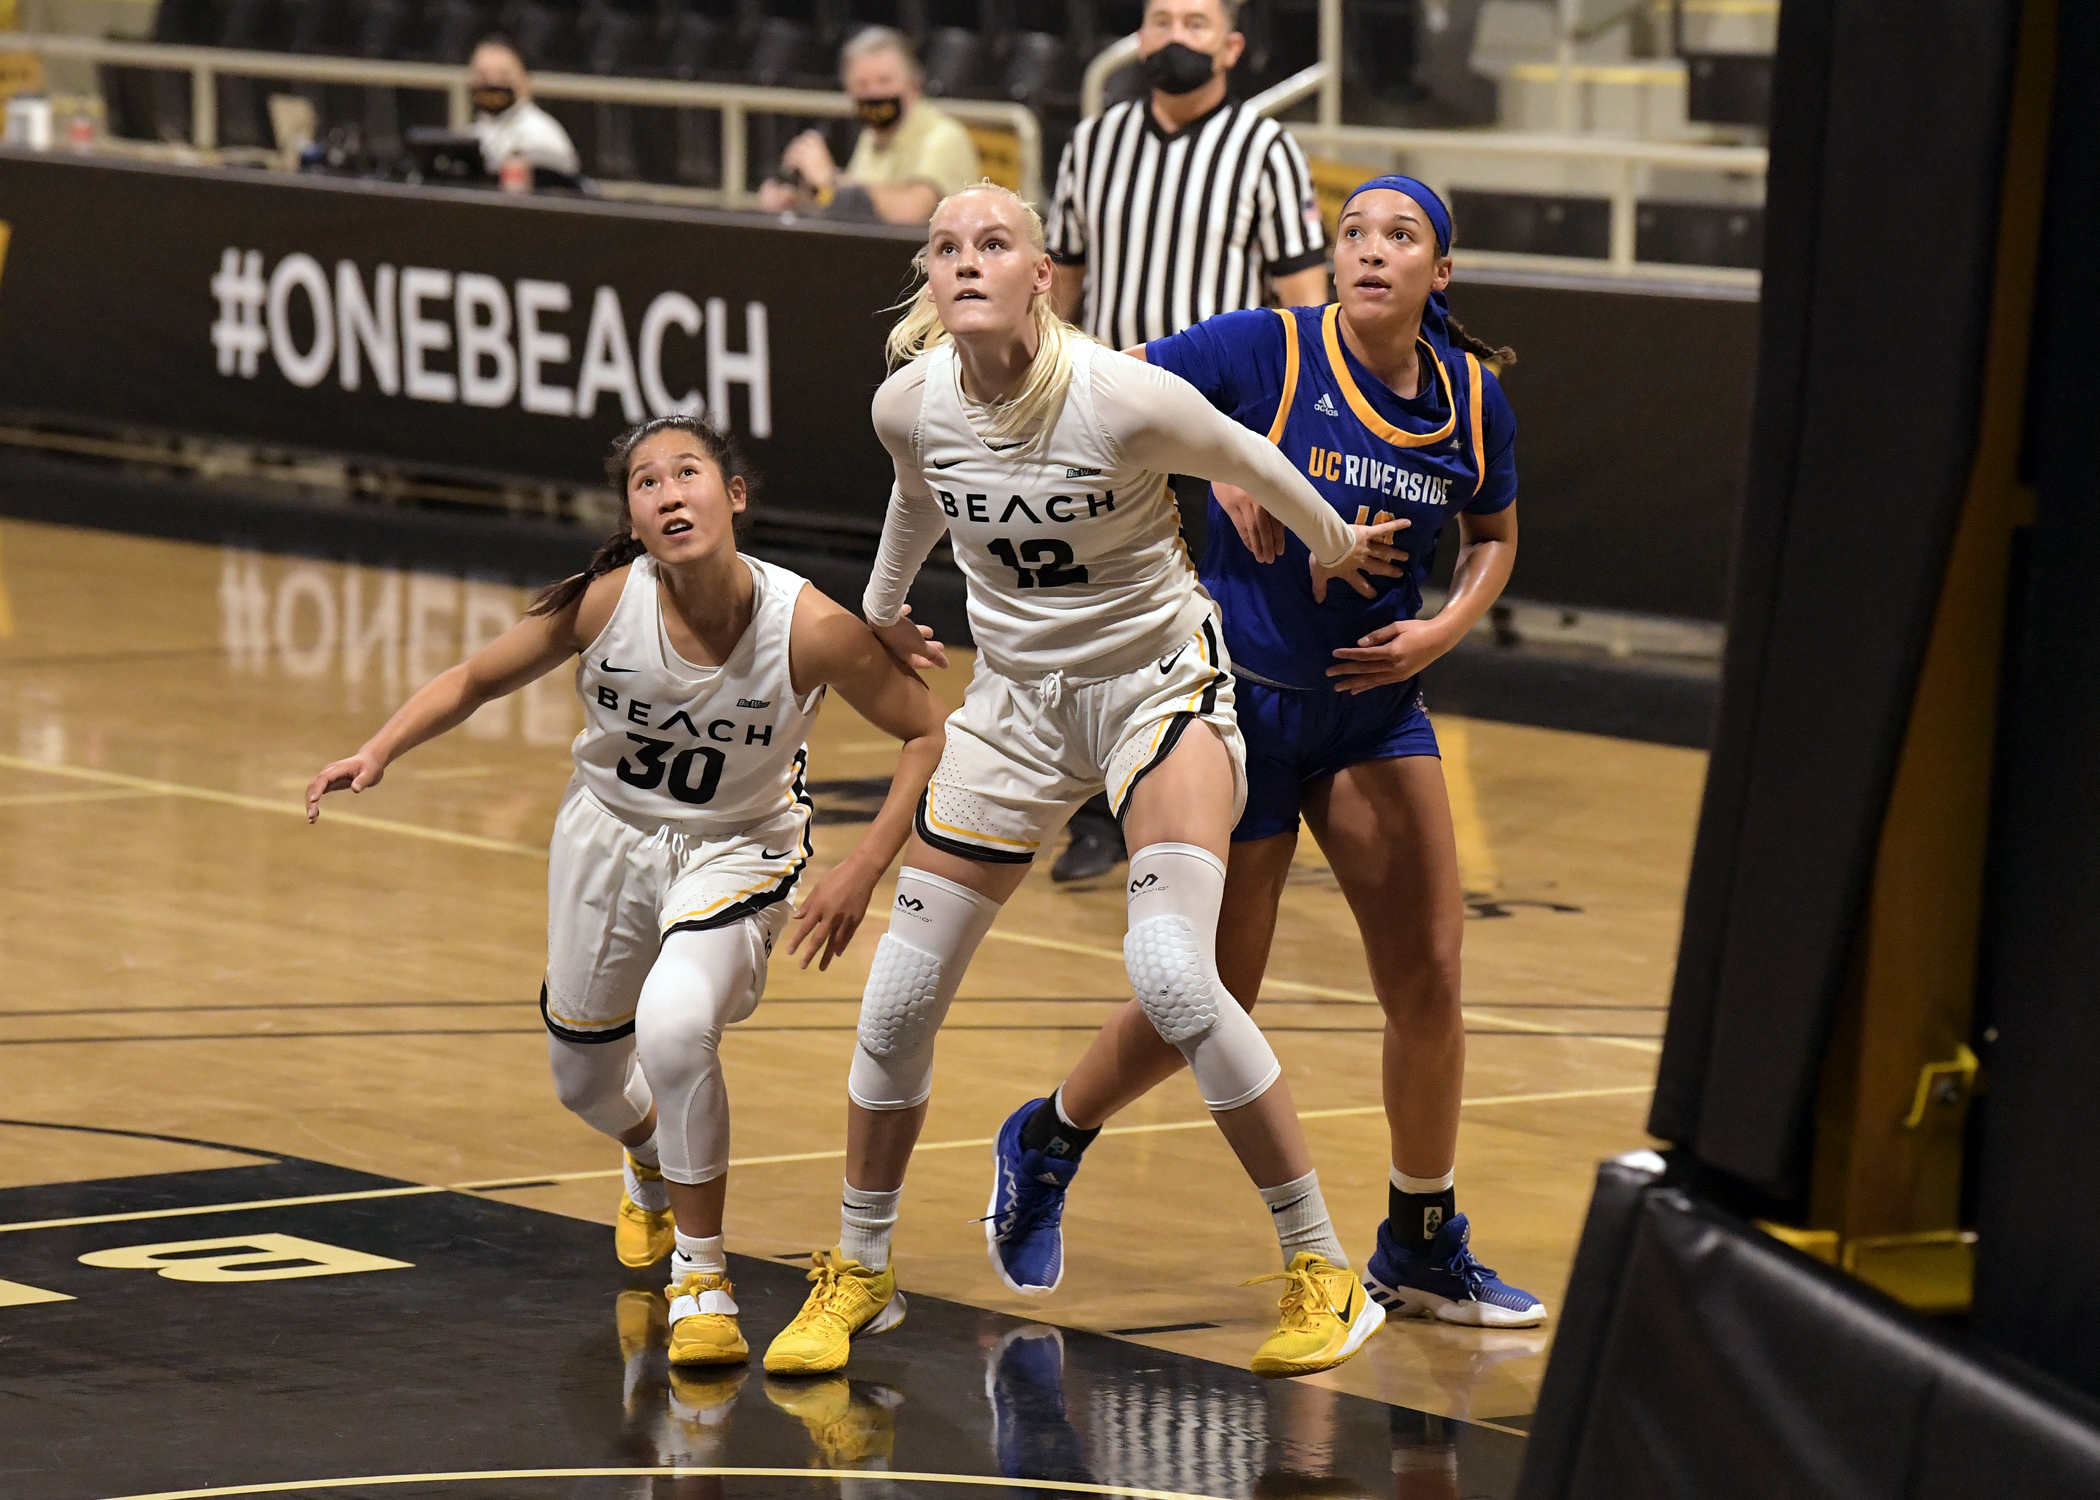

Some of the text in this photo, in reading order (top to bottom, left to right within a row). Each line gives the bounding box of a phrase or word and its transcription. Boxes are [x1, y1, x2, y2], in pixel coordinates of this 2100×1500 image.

[210, 247, 773, 439] #ONEBEACH
[1308, 446, 1453, 506] UC RIVERSIDE
[937, 490, 1116, 524] BEACH
[987, 538, 1089, 589] 12
[597, 685, 773, 746] BEACH
[616, 731, 726, 804] 30
